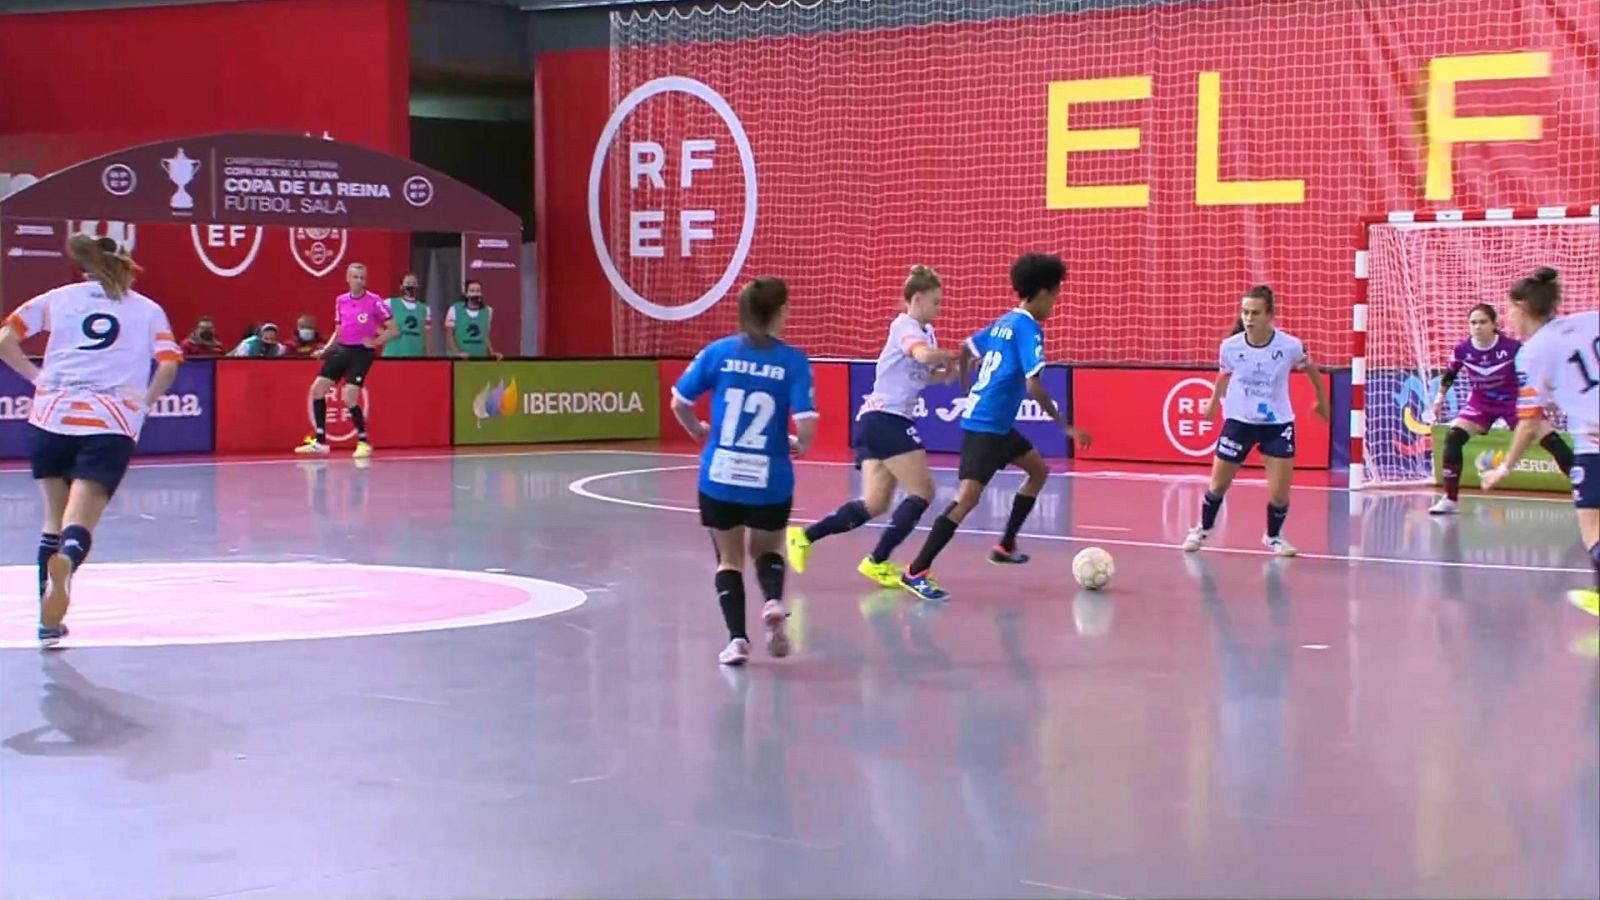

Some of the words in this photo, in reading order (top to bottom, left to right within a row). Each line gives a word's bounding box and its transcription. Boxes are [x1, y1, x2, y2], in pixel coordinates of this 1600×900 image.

[1045, 71, 1306, 210] EL
[224, 178, 276, 193] COPA
[280, 180, 306, 195] DE
[309, 182, 333, 196] LA
[337, 183, 391, 198] REINA
[301, 198, 348, 214] SALA
[77, 312, 121, 350] 9
[720, 358, 786, 380] JULIA
[148, 393, 203, 417] ma
[523, 391, 644, 414] IBERDROLA
[719, 388, 776, 450] 12
